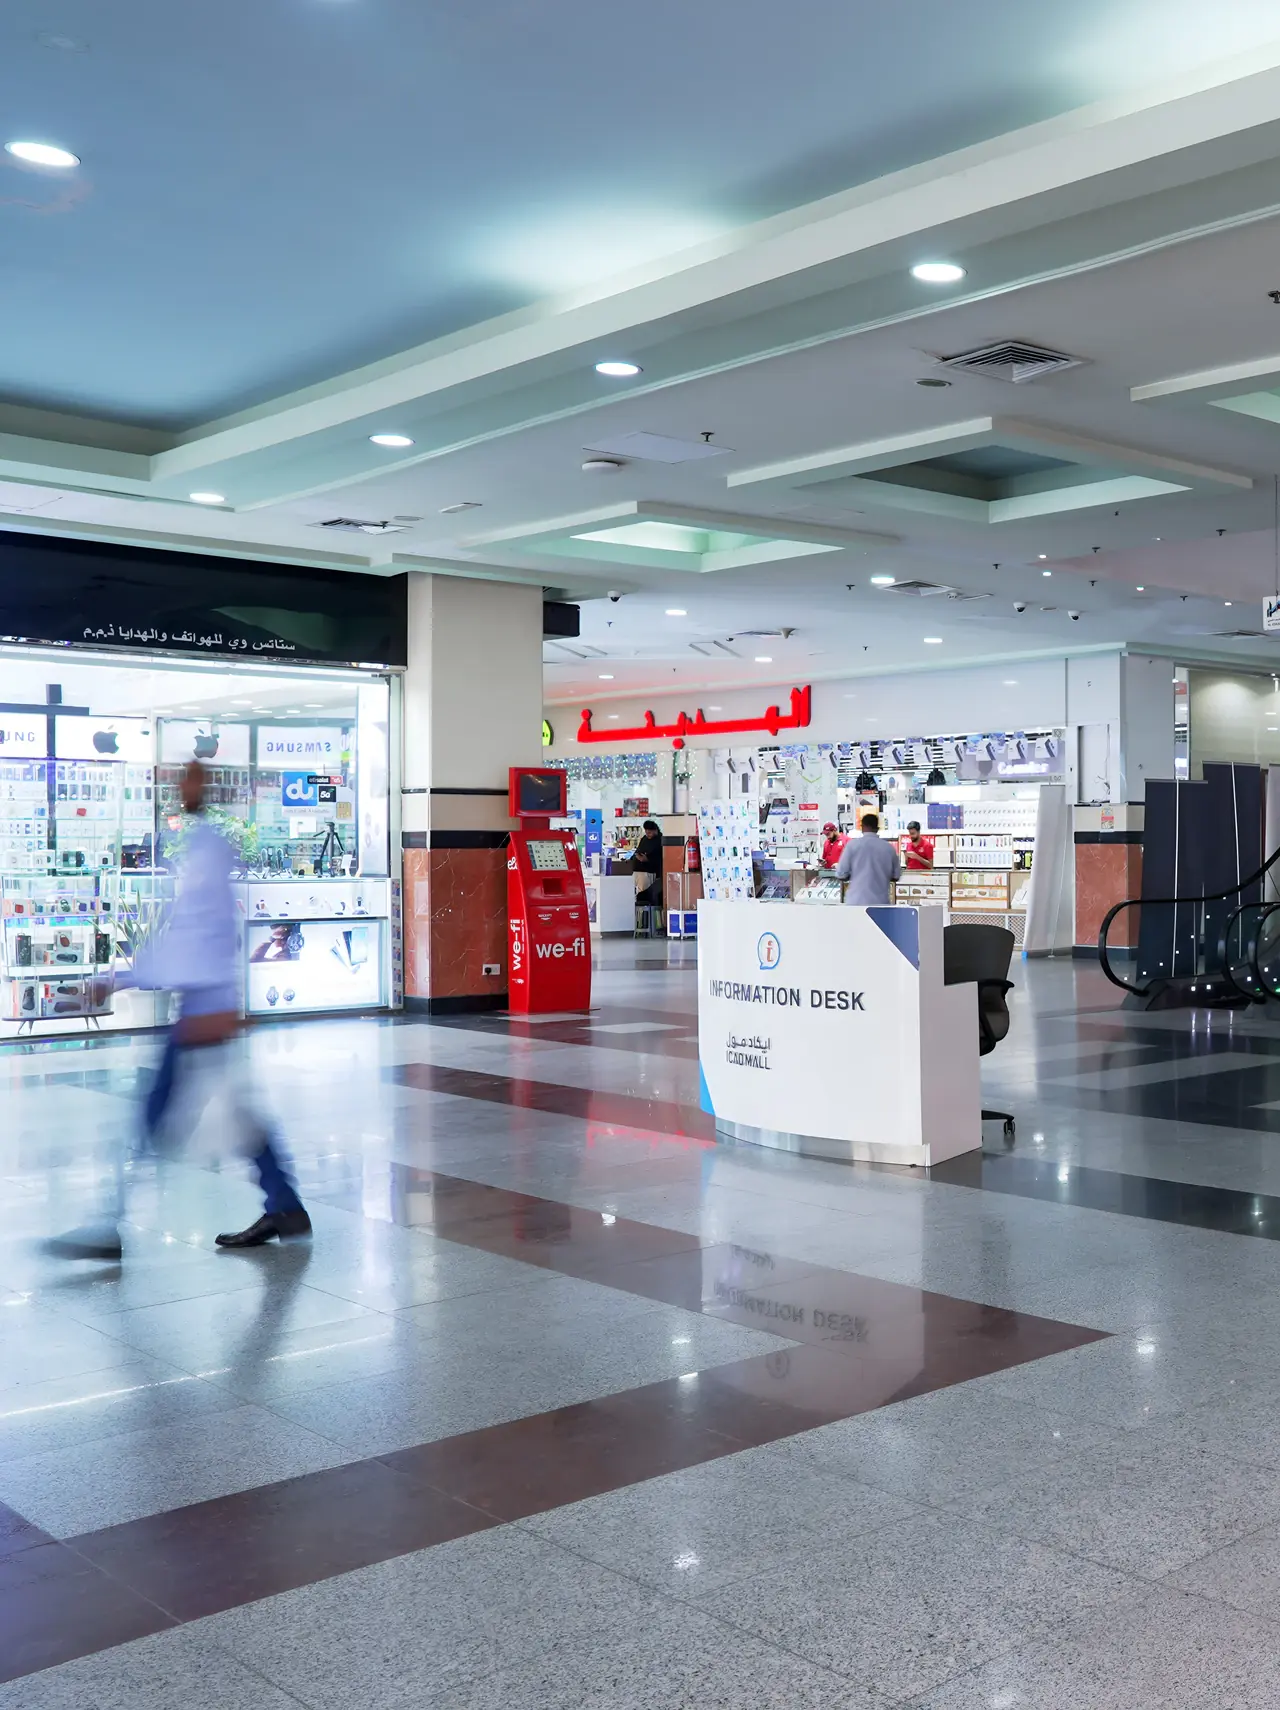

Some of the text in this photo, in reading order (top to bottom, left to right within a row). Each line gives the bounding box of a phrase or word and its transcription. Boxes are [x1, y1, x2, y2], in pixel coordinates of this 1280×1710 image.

[118, 626, 168, 642] والهدايا
[171, 631, 223, 647] للهواتف
[228, 639, 248, 650] وي
[286, 778, 314, 800] du
[510, 919, 521, 971] we-fi
[536, 937, 586, 959] we-fi
[709, 979, 865, 1011] INFORMATION DESK
